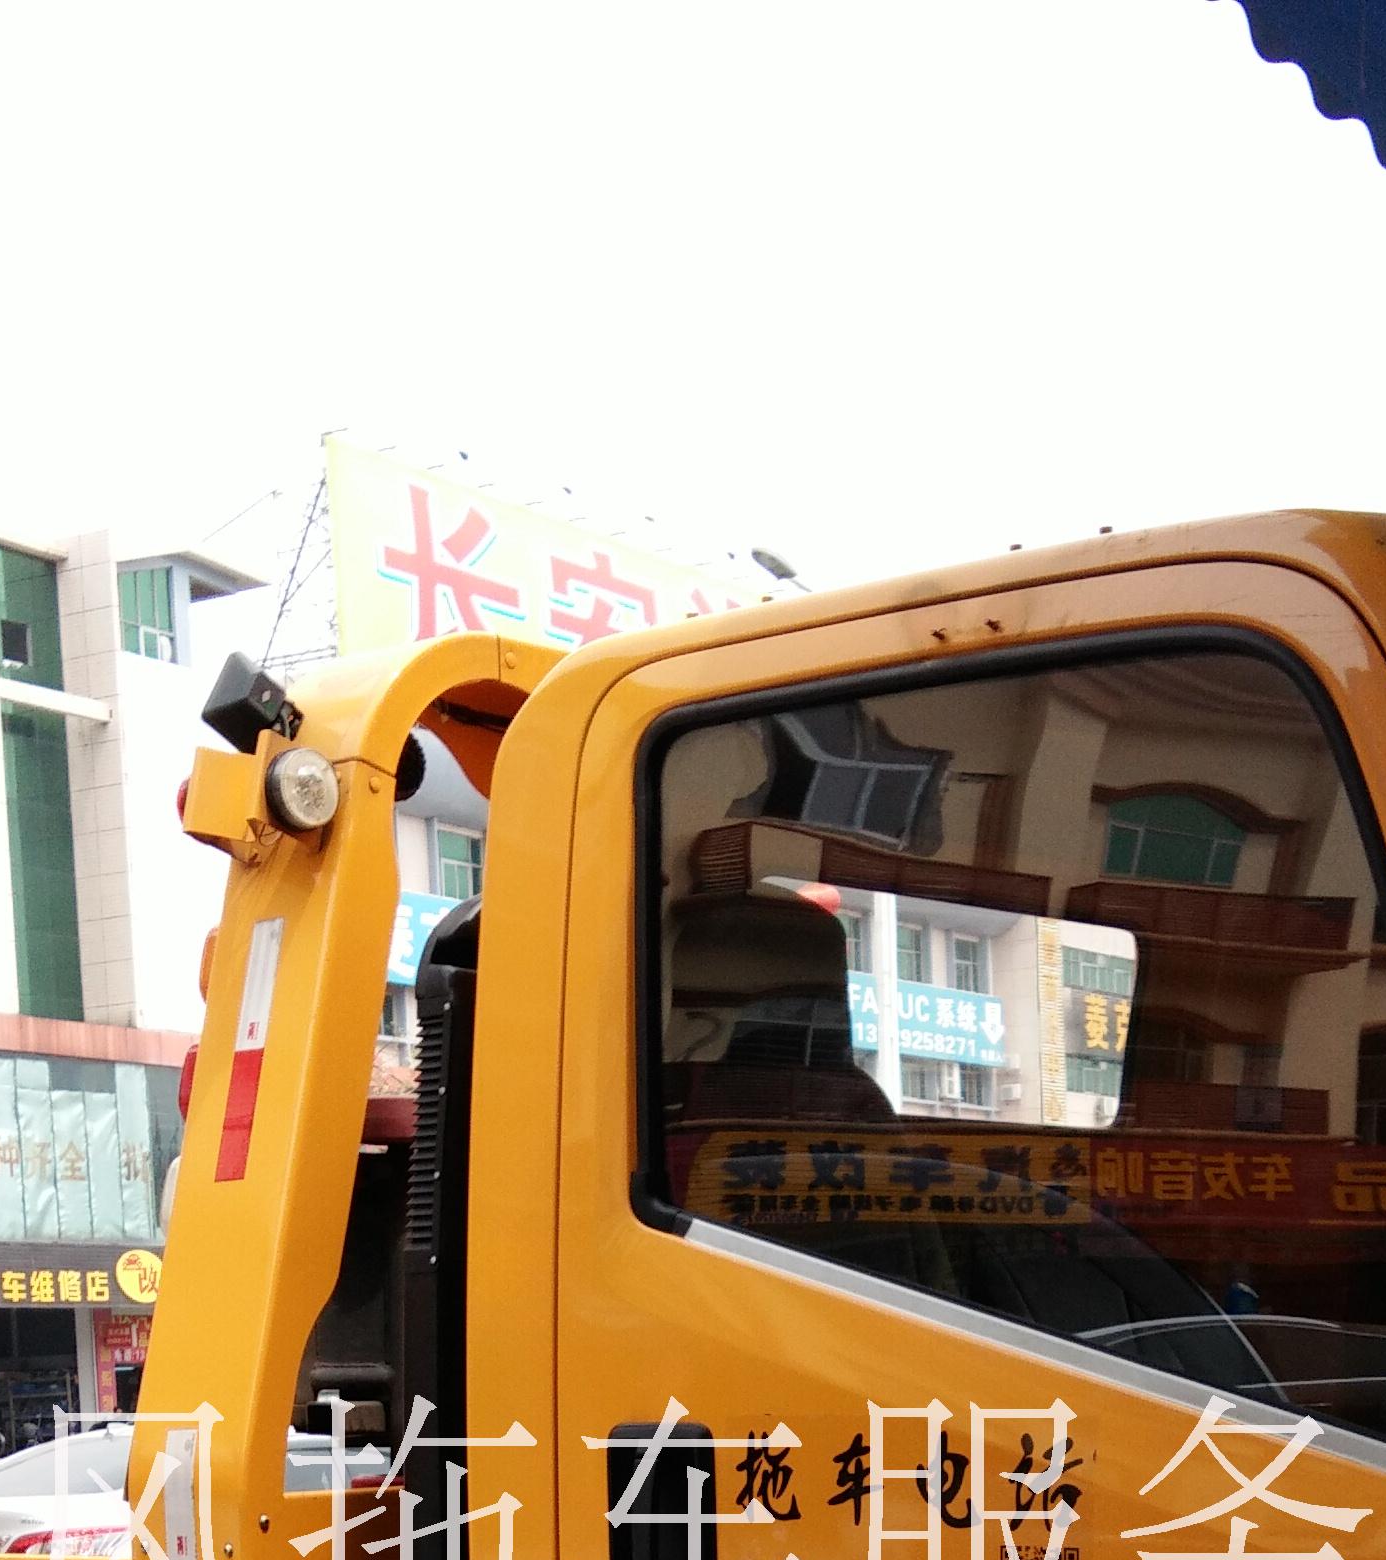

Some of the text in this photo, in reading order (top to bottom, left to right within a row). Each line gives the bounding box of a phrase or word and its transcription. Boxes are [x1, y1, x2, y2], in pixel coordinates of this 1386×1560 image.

[384, 484, 738, 645] 长安
[848, 982, 930, 1023] FAUC
[853, 1021, 976, 1057] 139258271
